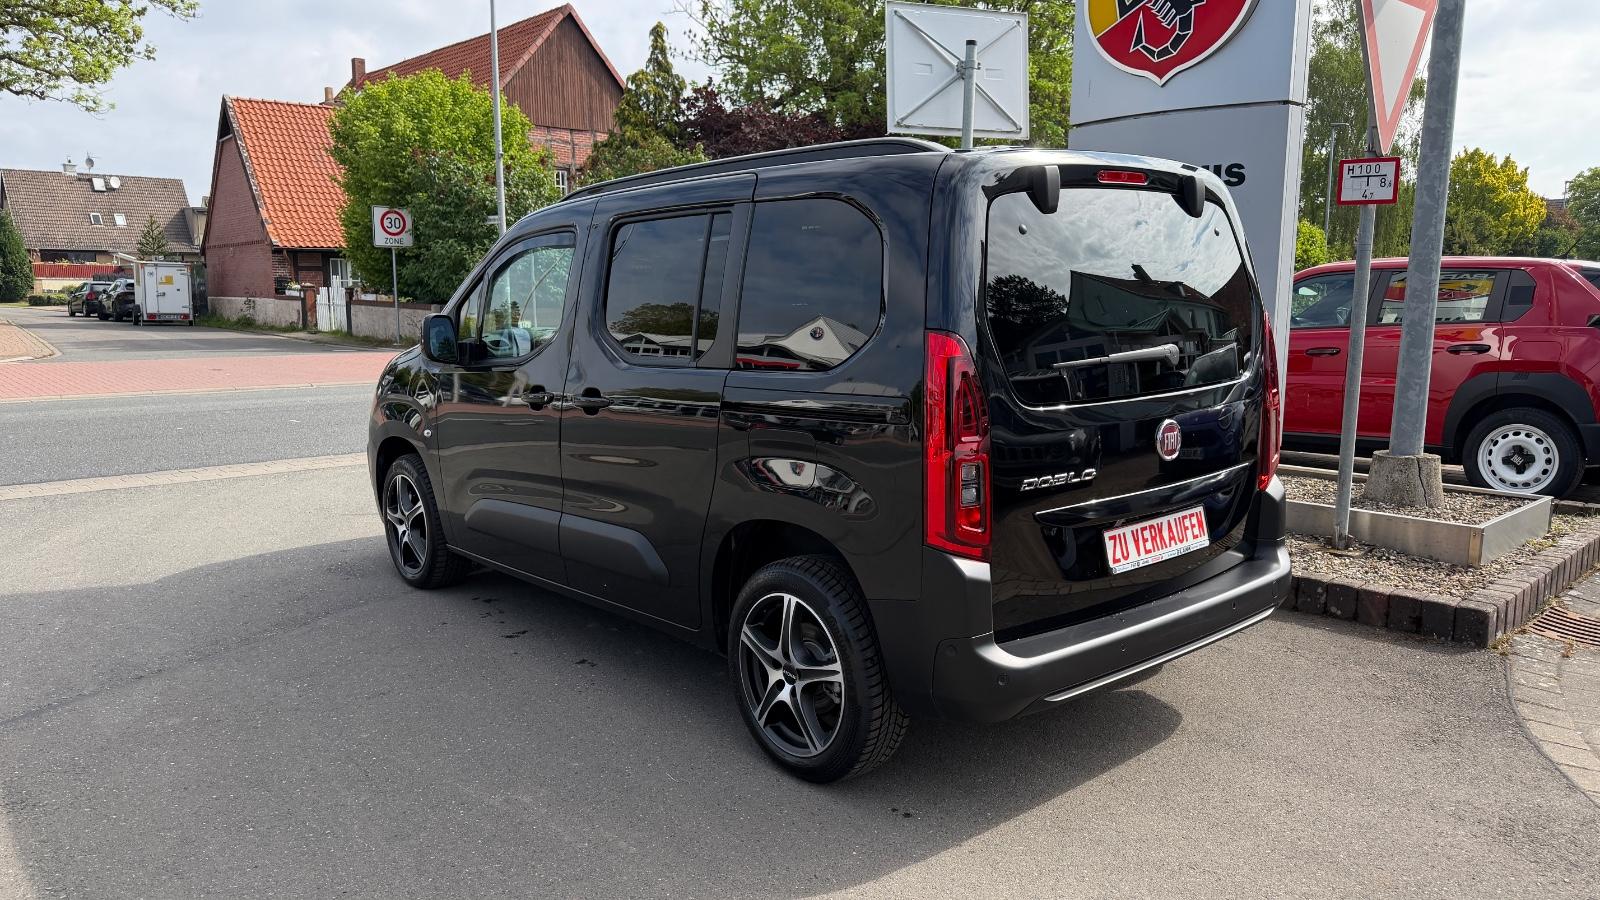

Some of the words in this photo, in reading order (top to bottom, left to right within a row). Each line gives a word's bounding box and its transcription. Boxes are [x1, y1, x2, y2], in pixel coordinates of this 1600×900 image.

[385, 217, 401, 229] 30
[1164, 431, 1178, 450] FIAT
[1020, 468, 1096, 491] DOBLO
[1108, 530, 1130, 565] ZU
[1131, 511, 1205, 556] VERKAUFEN
